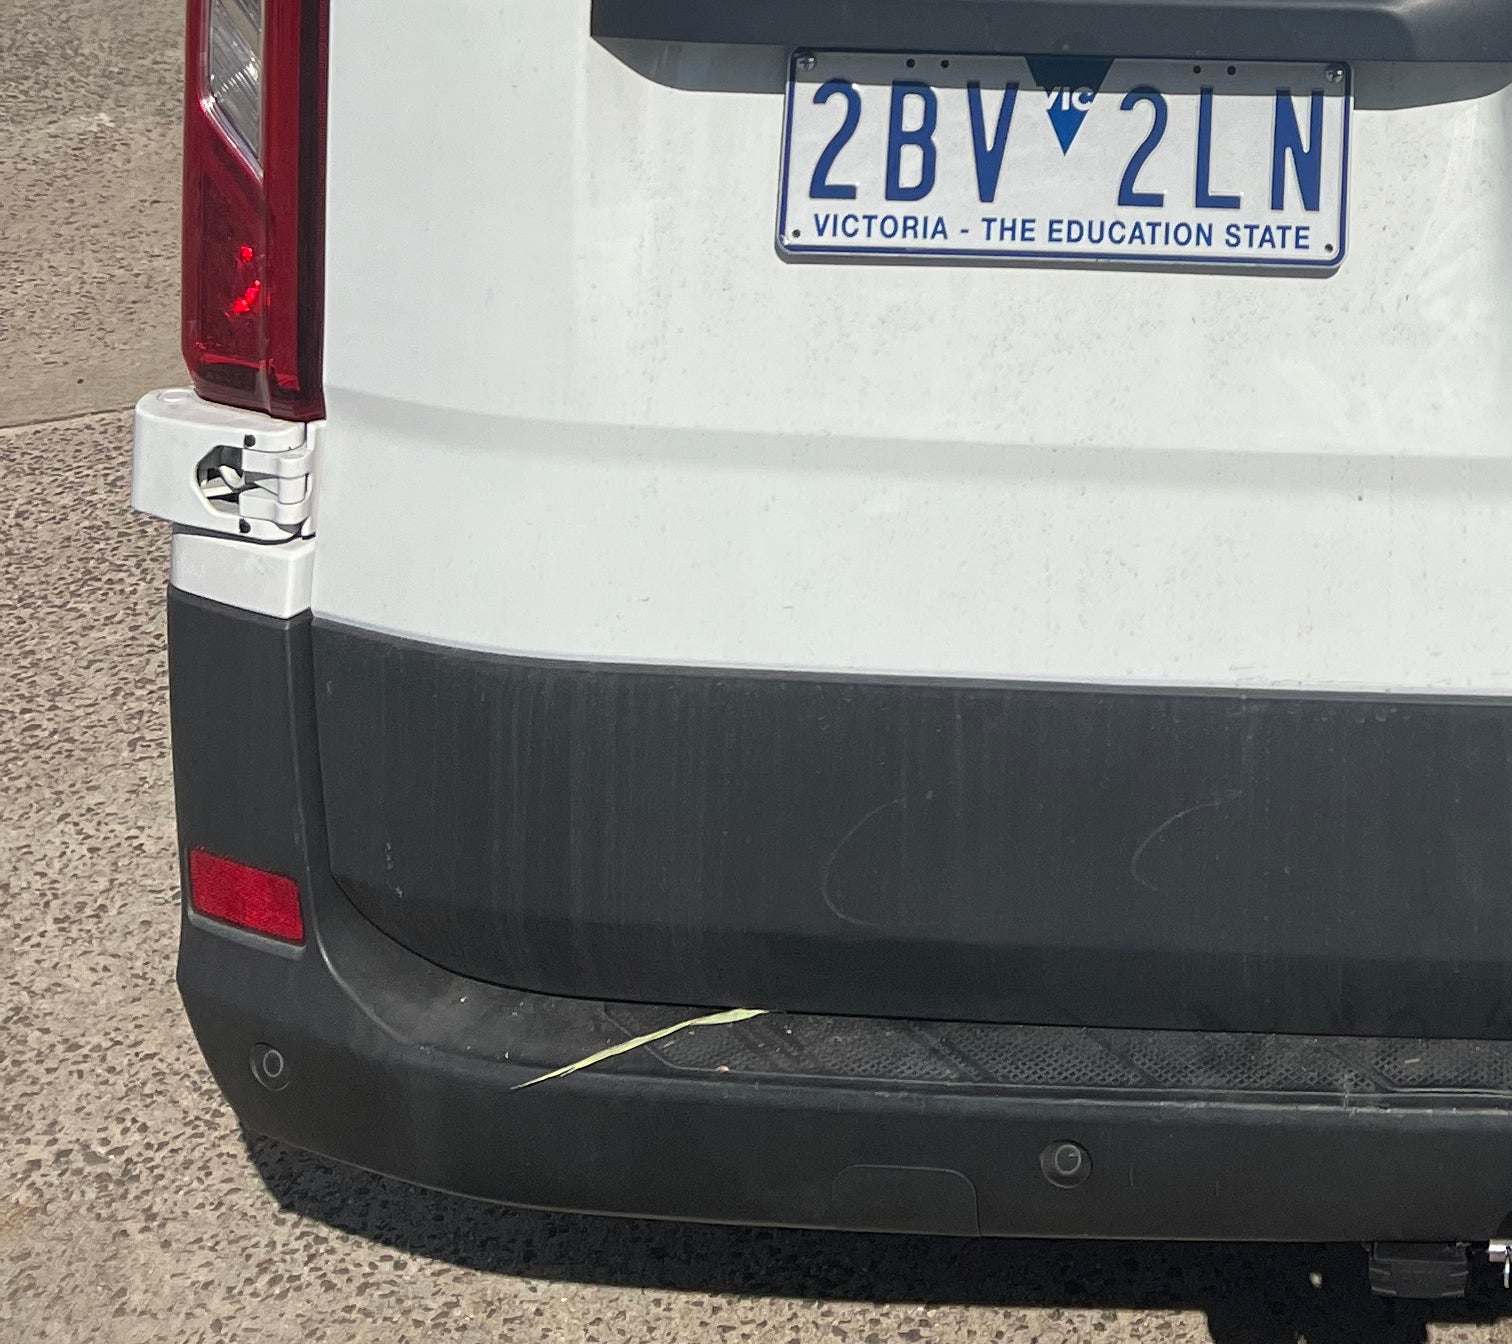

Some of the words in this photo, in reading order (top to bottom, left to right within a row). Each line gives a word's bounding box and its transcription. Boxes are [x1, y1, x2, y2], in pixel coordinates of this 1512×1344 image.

[1042, 86, 1096, 111] VIC
[808, 79, 1020, 204] 2BV
[1117, 85, 1326, 212] 2LN
[813, 213, 949, 241] VICTORIA
[981, 217, 1037, 243] THE
[1047, 219, 1219, 247] EDUCATION
[1224, 224, 1311, 250] STATE
